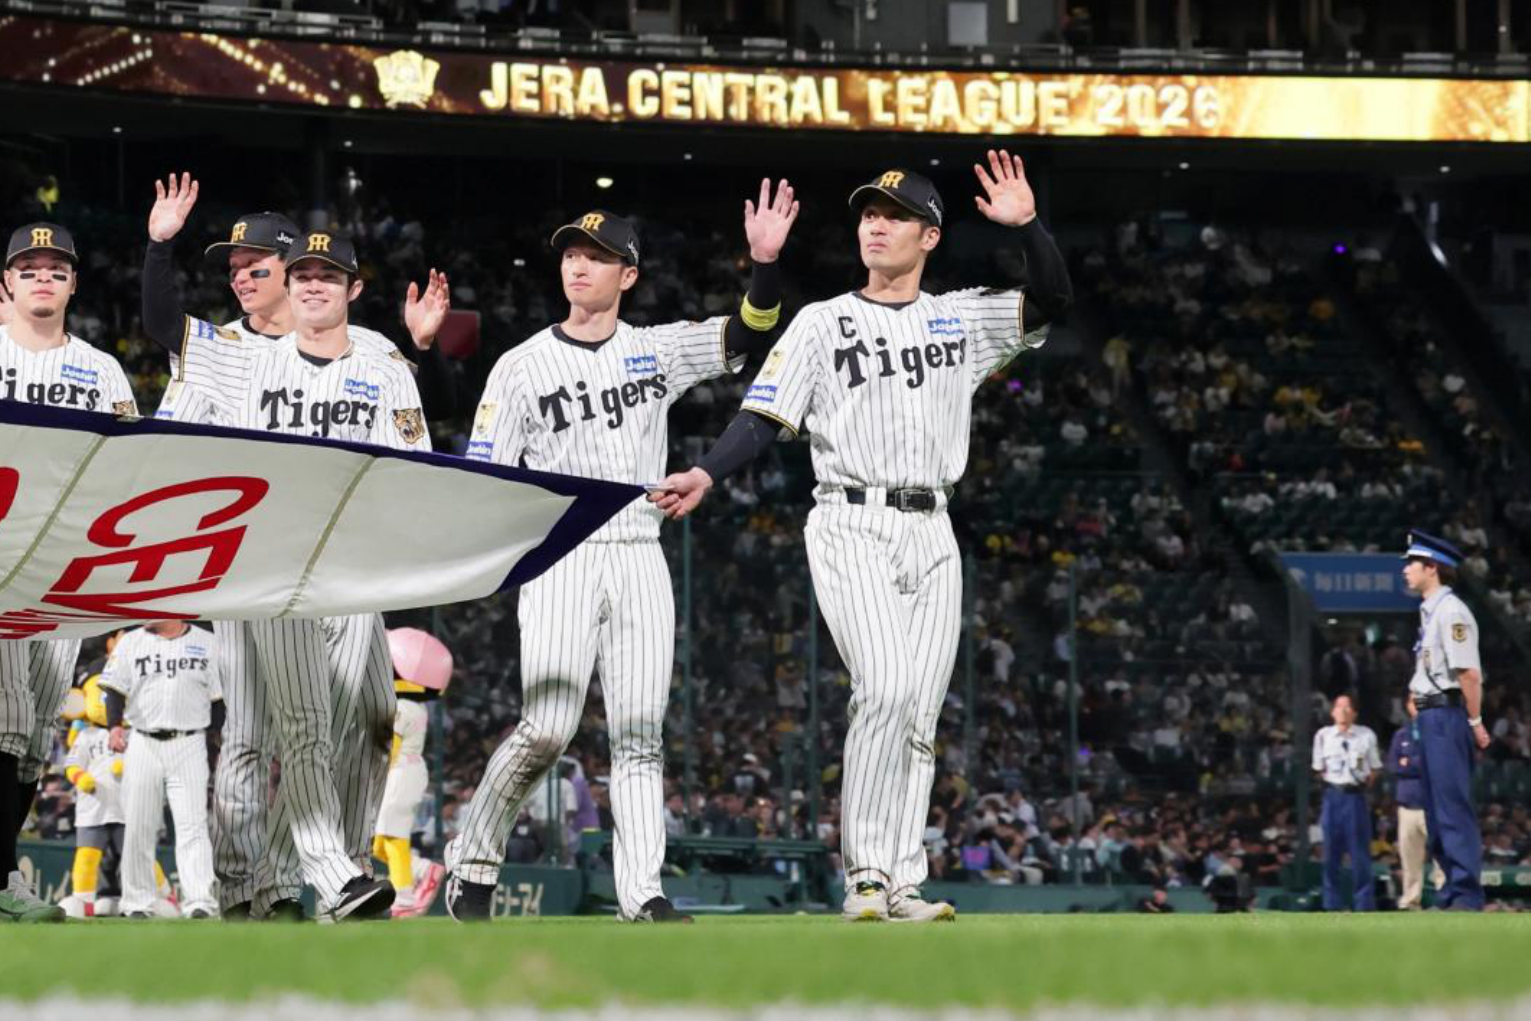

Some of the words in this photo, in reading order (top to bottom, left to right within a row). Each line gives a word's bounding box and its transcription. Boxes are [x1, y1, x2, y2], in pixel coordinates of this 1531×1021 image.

[479, 61, 605, 116] JERA
[627, 69, 850, 126] CENTRAL
[868, 79, 1070, 129] LEAGUE
[1095, 83, 1221, 129] 2026
[838, 316, 857, 339] C
[834, 336, 967, 389] Tigers
[539, 373, 668, 433] Tigers
[135, 654, 210, 679] Tigers
